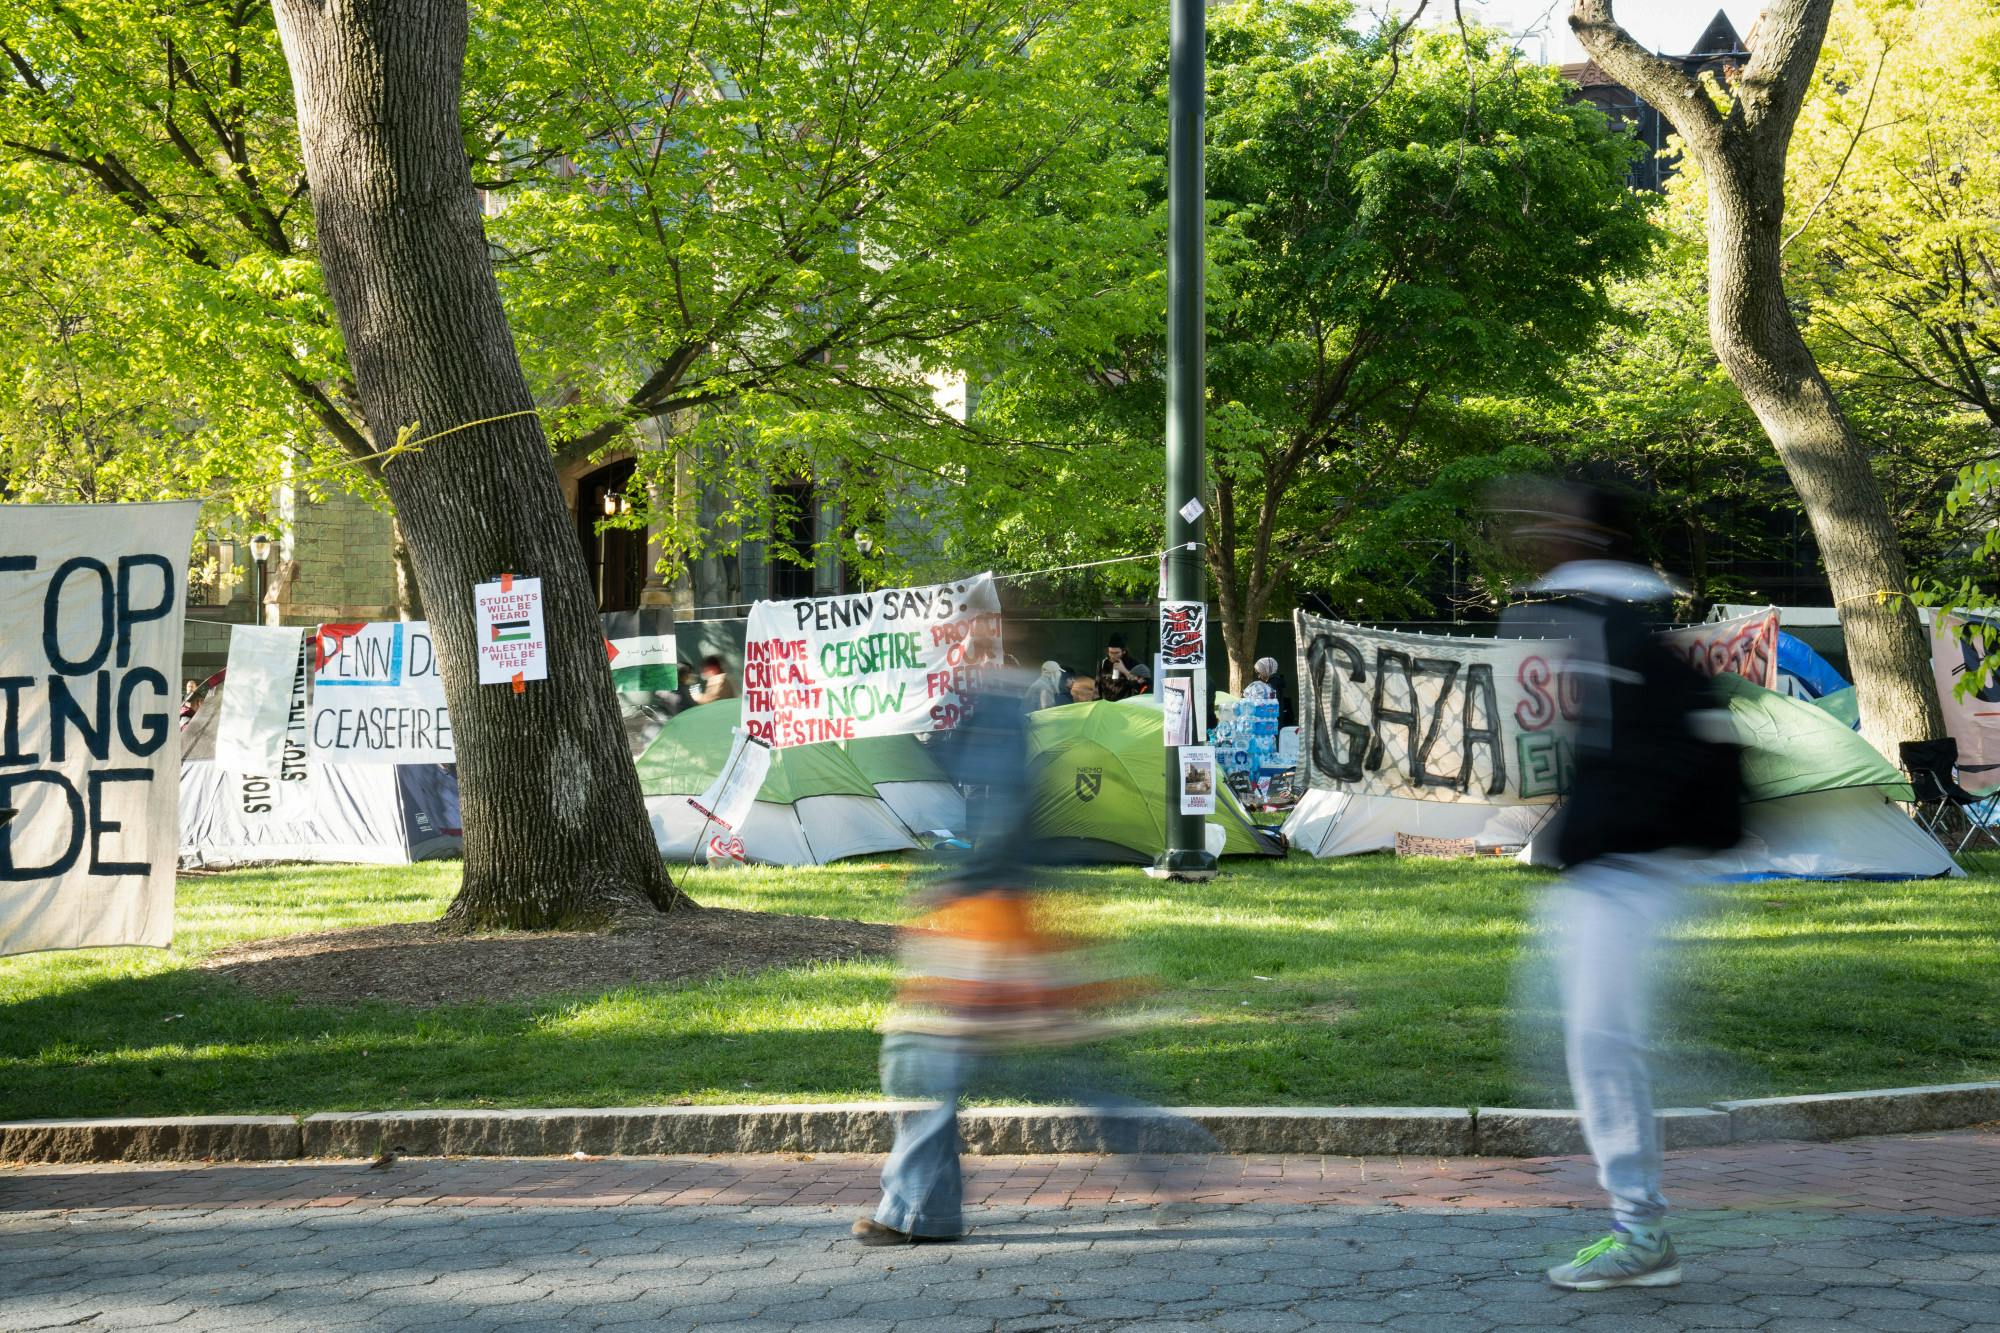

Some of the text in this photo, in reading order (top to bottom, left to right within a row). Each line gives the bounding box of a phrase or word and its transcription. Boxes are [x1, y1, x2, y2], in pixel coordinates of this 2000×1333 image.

[480, 593, 538, 606] STUDENTS
[487, 601, 532, 613] WILL BE
[793, 585, 968, 631] PENN SAYS:
[491, 610, 529, 621] HEARD
[321, 634, 391, 678] PENN
[482, 641, 544, 654] PALESTINE
[490, 650, 535, 661] WILL BE
[820, 631, 927, 678] CEASEFIRE
[499, 658, 527, 668] FREE
[826, 682, 906, 721] NOW
[1307, 633, 1506, 795] GAZA
[314, 706, 453, 751] CEASEFIRE
